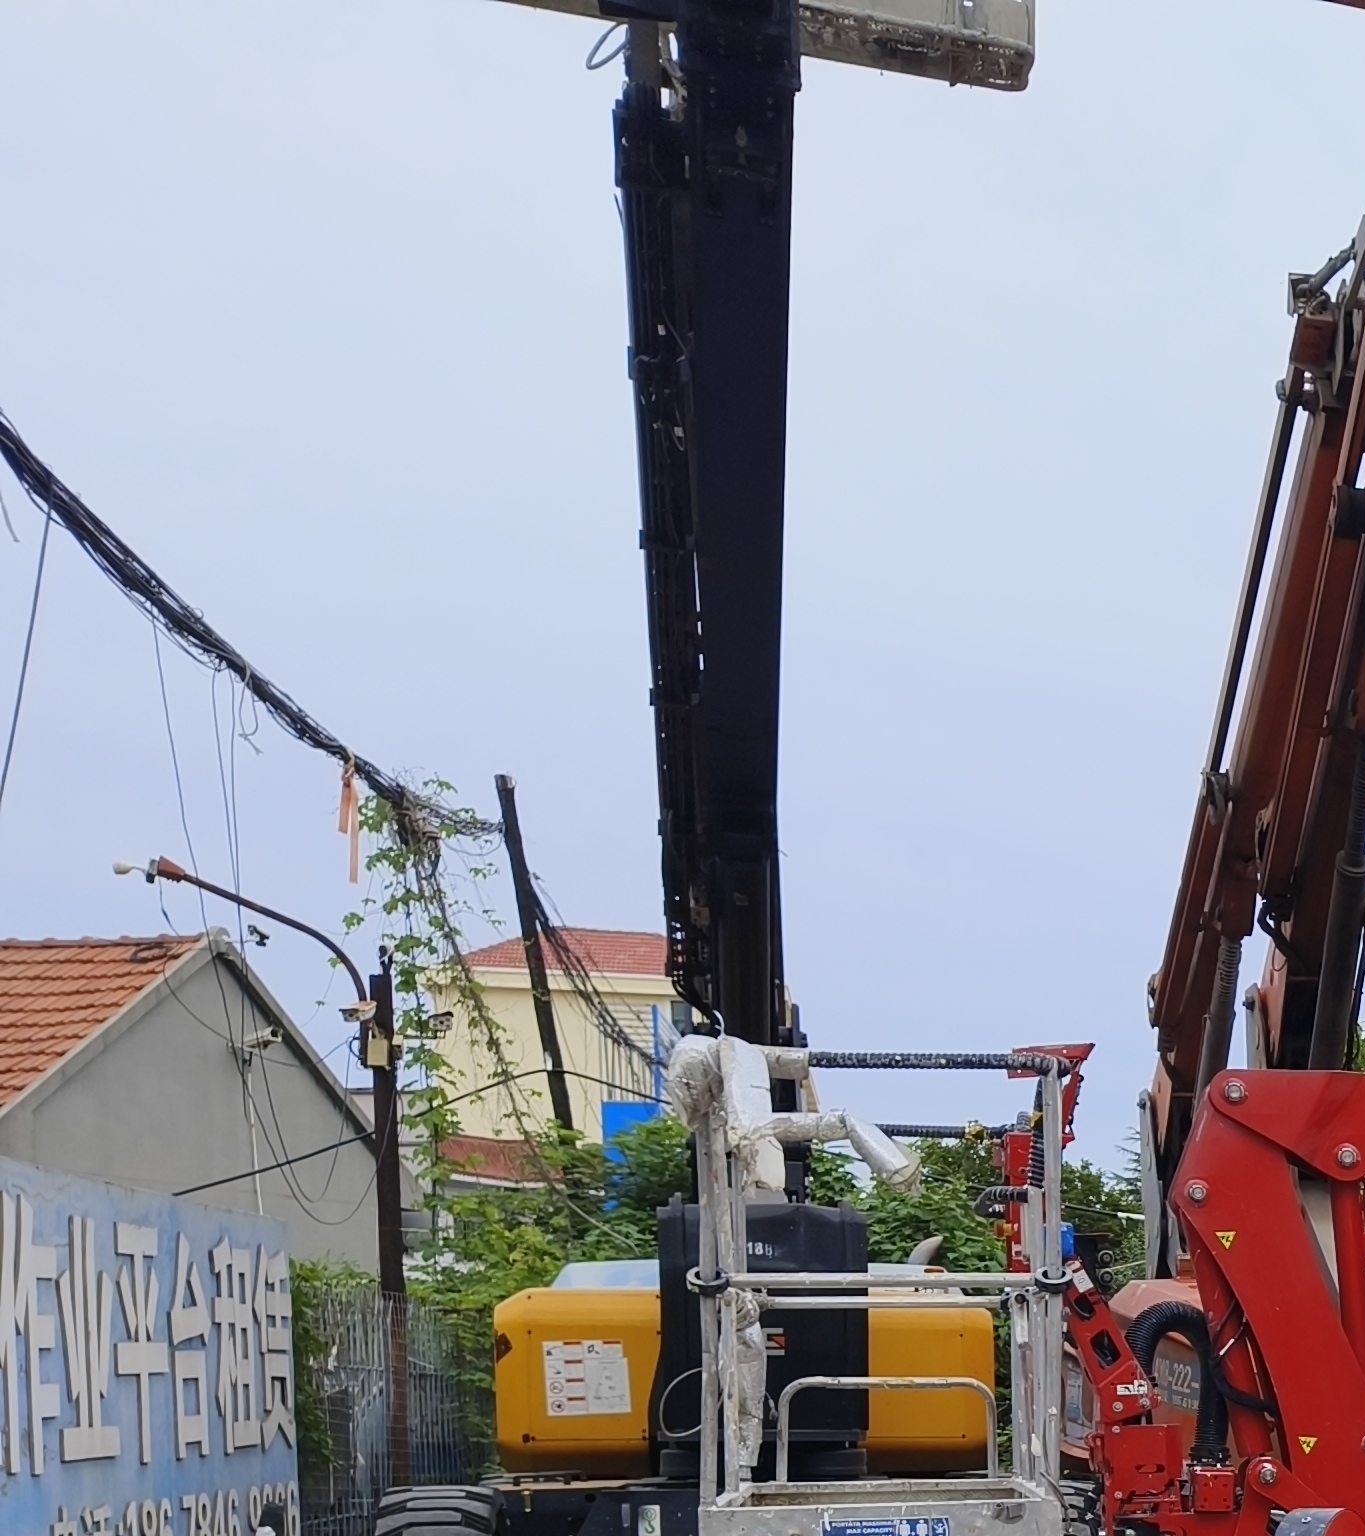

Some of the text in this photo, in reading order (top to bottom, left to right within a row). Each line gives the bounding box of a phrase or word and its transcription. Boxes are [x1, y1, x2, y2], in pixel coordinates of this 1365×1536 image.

[0, 1187, 296, 1476] 作业平台租赁
